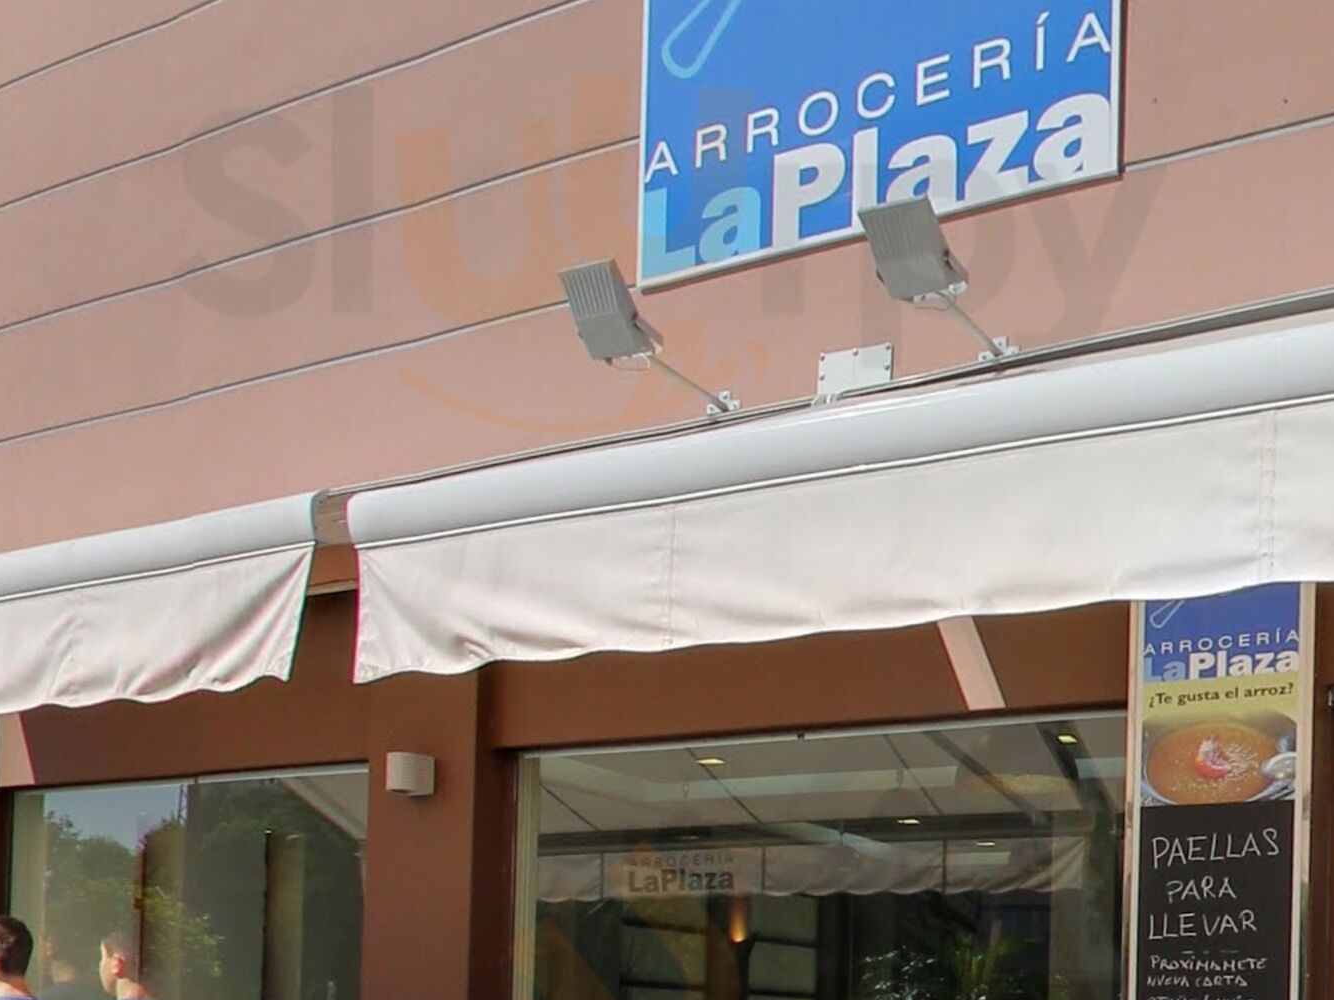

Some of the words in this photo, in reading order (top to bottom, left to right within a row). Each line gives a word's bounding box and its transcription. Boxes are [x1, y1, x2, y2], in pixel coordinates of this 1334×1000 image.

[644, 12, 1112, 183] ARROCERÍA
[641, 92, 1112, 278] LaPlaza
[1144, 628, 1300, 656] ARROCERÍA
[1143, 649, 1300, 683] LaPlaza
[1149, 692, 1173, 708] ¿Te
[1177, 690, 1220, 706] gusta
[1225, 687, 1239, 699] el
[1244, 682, 1294, 698] arroz?
[1152, 828, 1280, 869] PAELLAS
[629, 868, 734, 892] LaPlaza
[1166, 875, 1237, 904] PARA
[1148, 909, 1257, 940] LLEVAR
